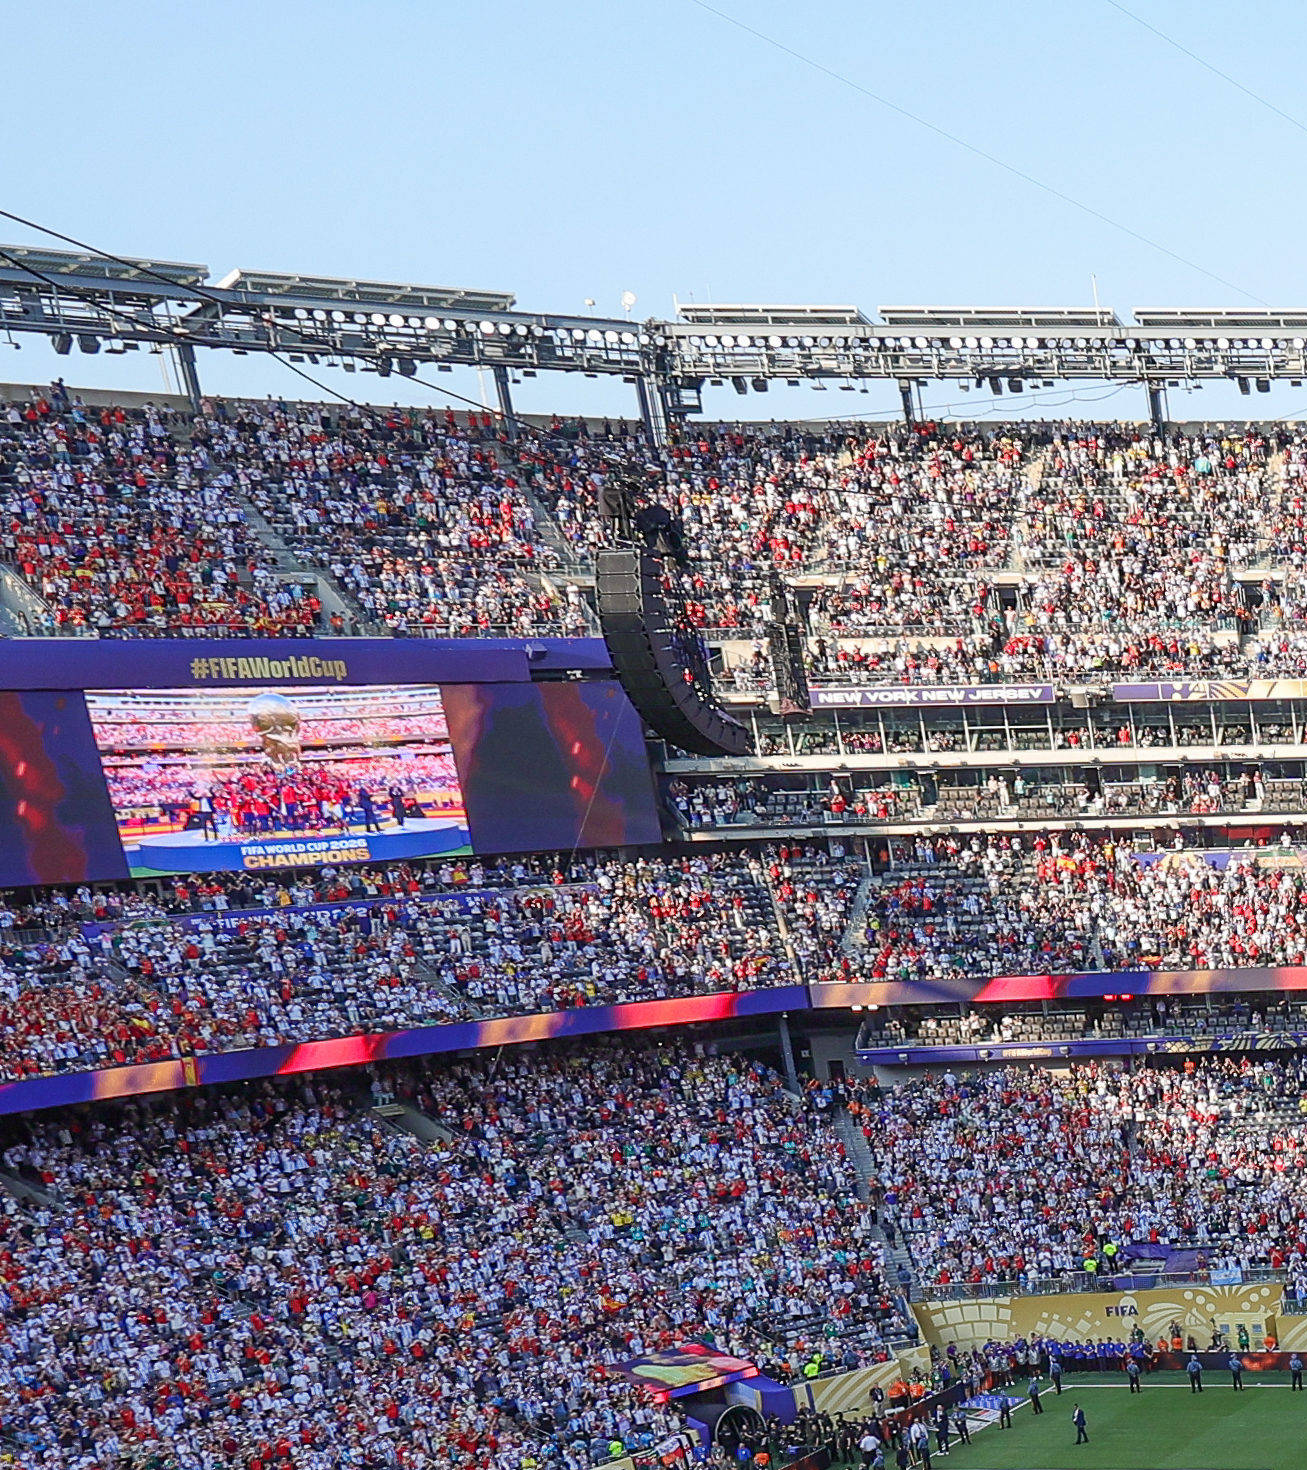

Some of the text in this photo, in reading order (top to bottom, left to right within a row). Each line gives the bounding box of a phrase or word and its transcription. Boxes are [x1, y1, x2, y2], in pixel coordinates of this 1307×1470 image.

[190, 656, 347, 681] #FIFAWorldCup
[819, 688, 1043, 704] NEW YORK NEW JERSEY
[241, 838, 367, 855] FIFA WORLD CUP 2026
[244, 849, 371, 868] CHAMPIONS
[1105, 1305, 1138, 1317] FIFA
